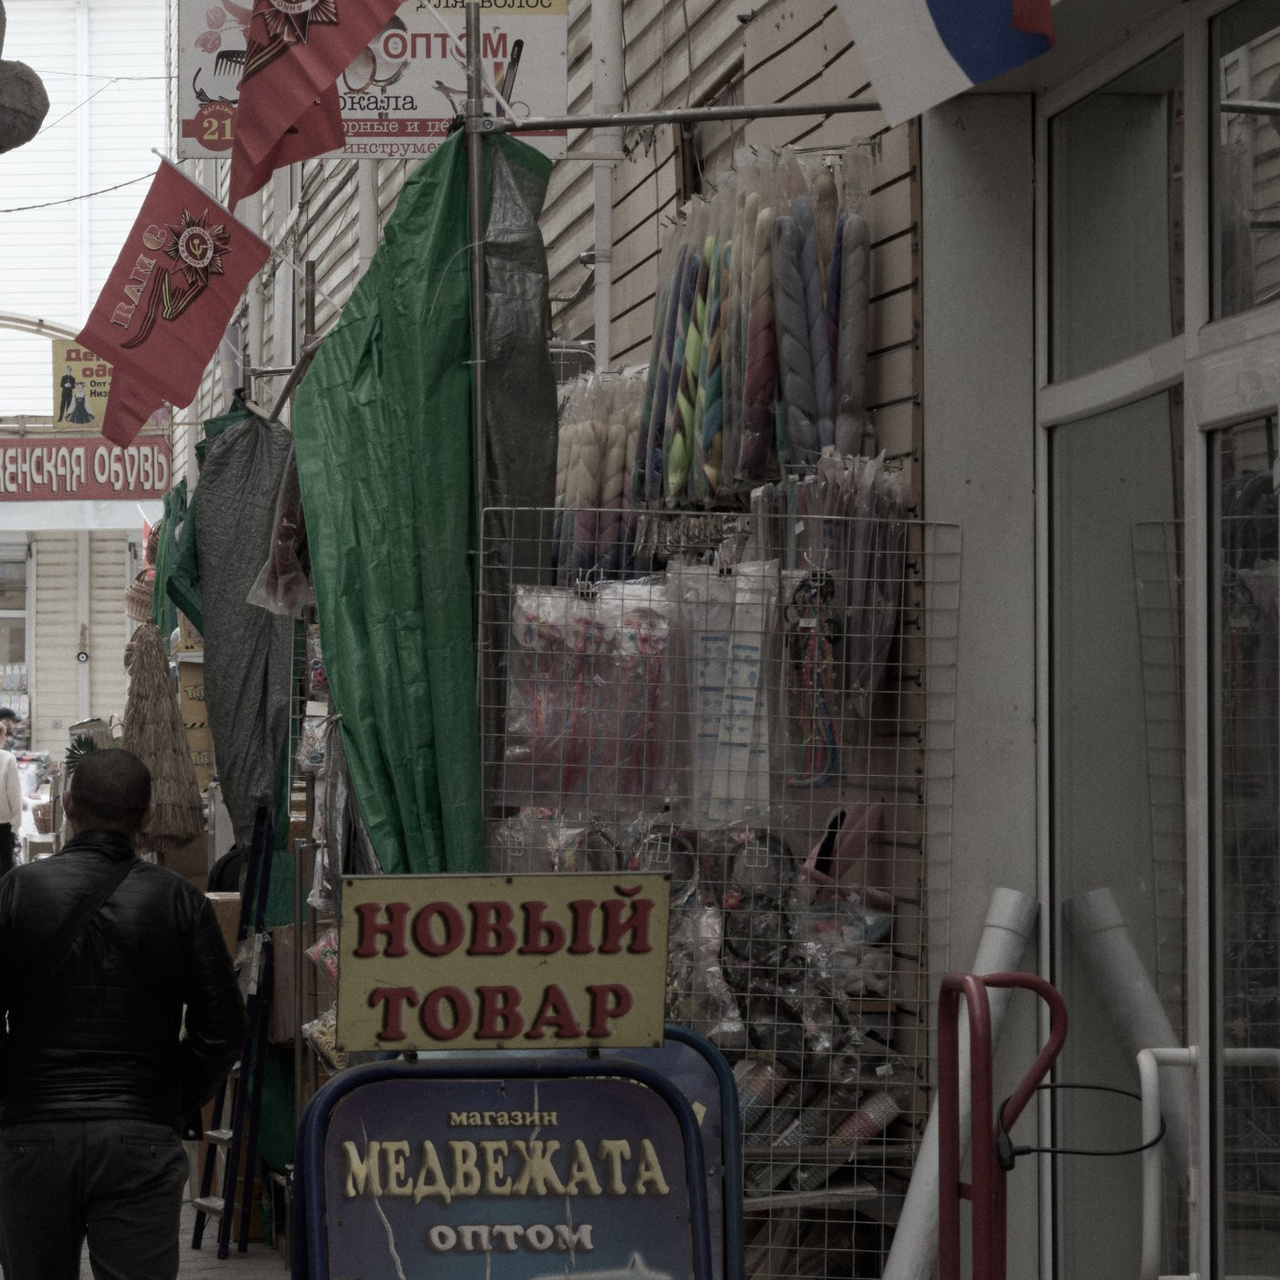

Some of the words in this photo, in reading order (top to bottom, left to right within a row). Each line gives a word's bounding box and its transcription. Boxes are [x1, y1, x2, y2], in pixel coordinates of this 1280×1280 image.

[202, 117, 234, 140] 21
[93, 444, 169, 492] ОБУВЬ
[353, 886, 655, 958] НОВЫЙ
[368, 984, 634, 1041] ТОВАР
[449, 1111, 559, 1127] магазин
[341, 1138, 671, 1205] МЕДВЕЖАТА
